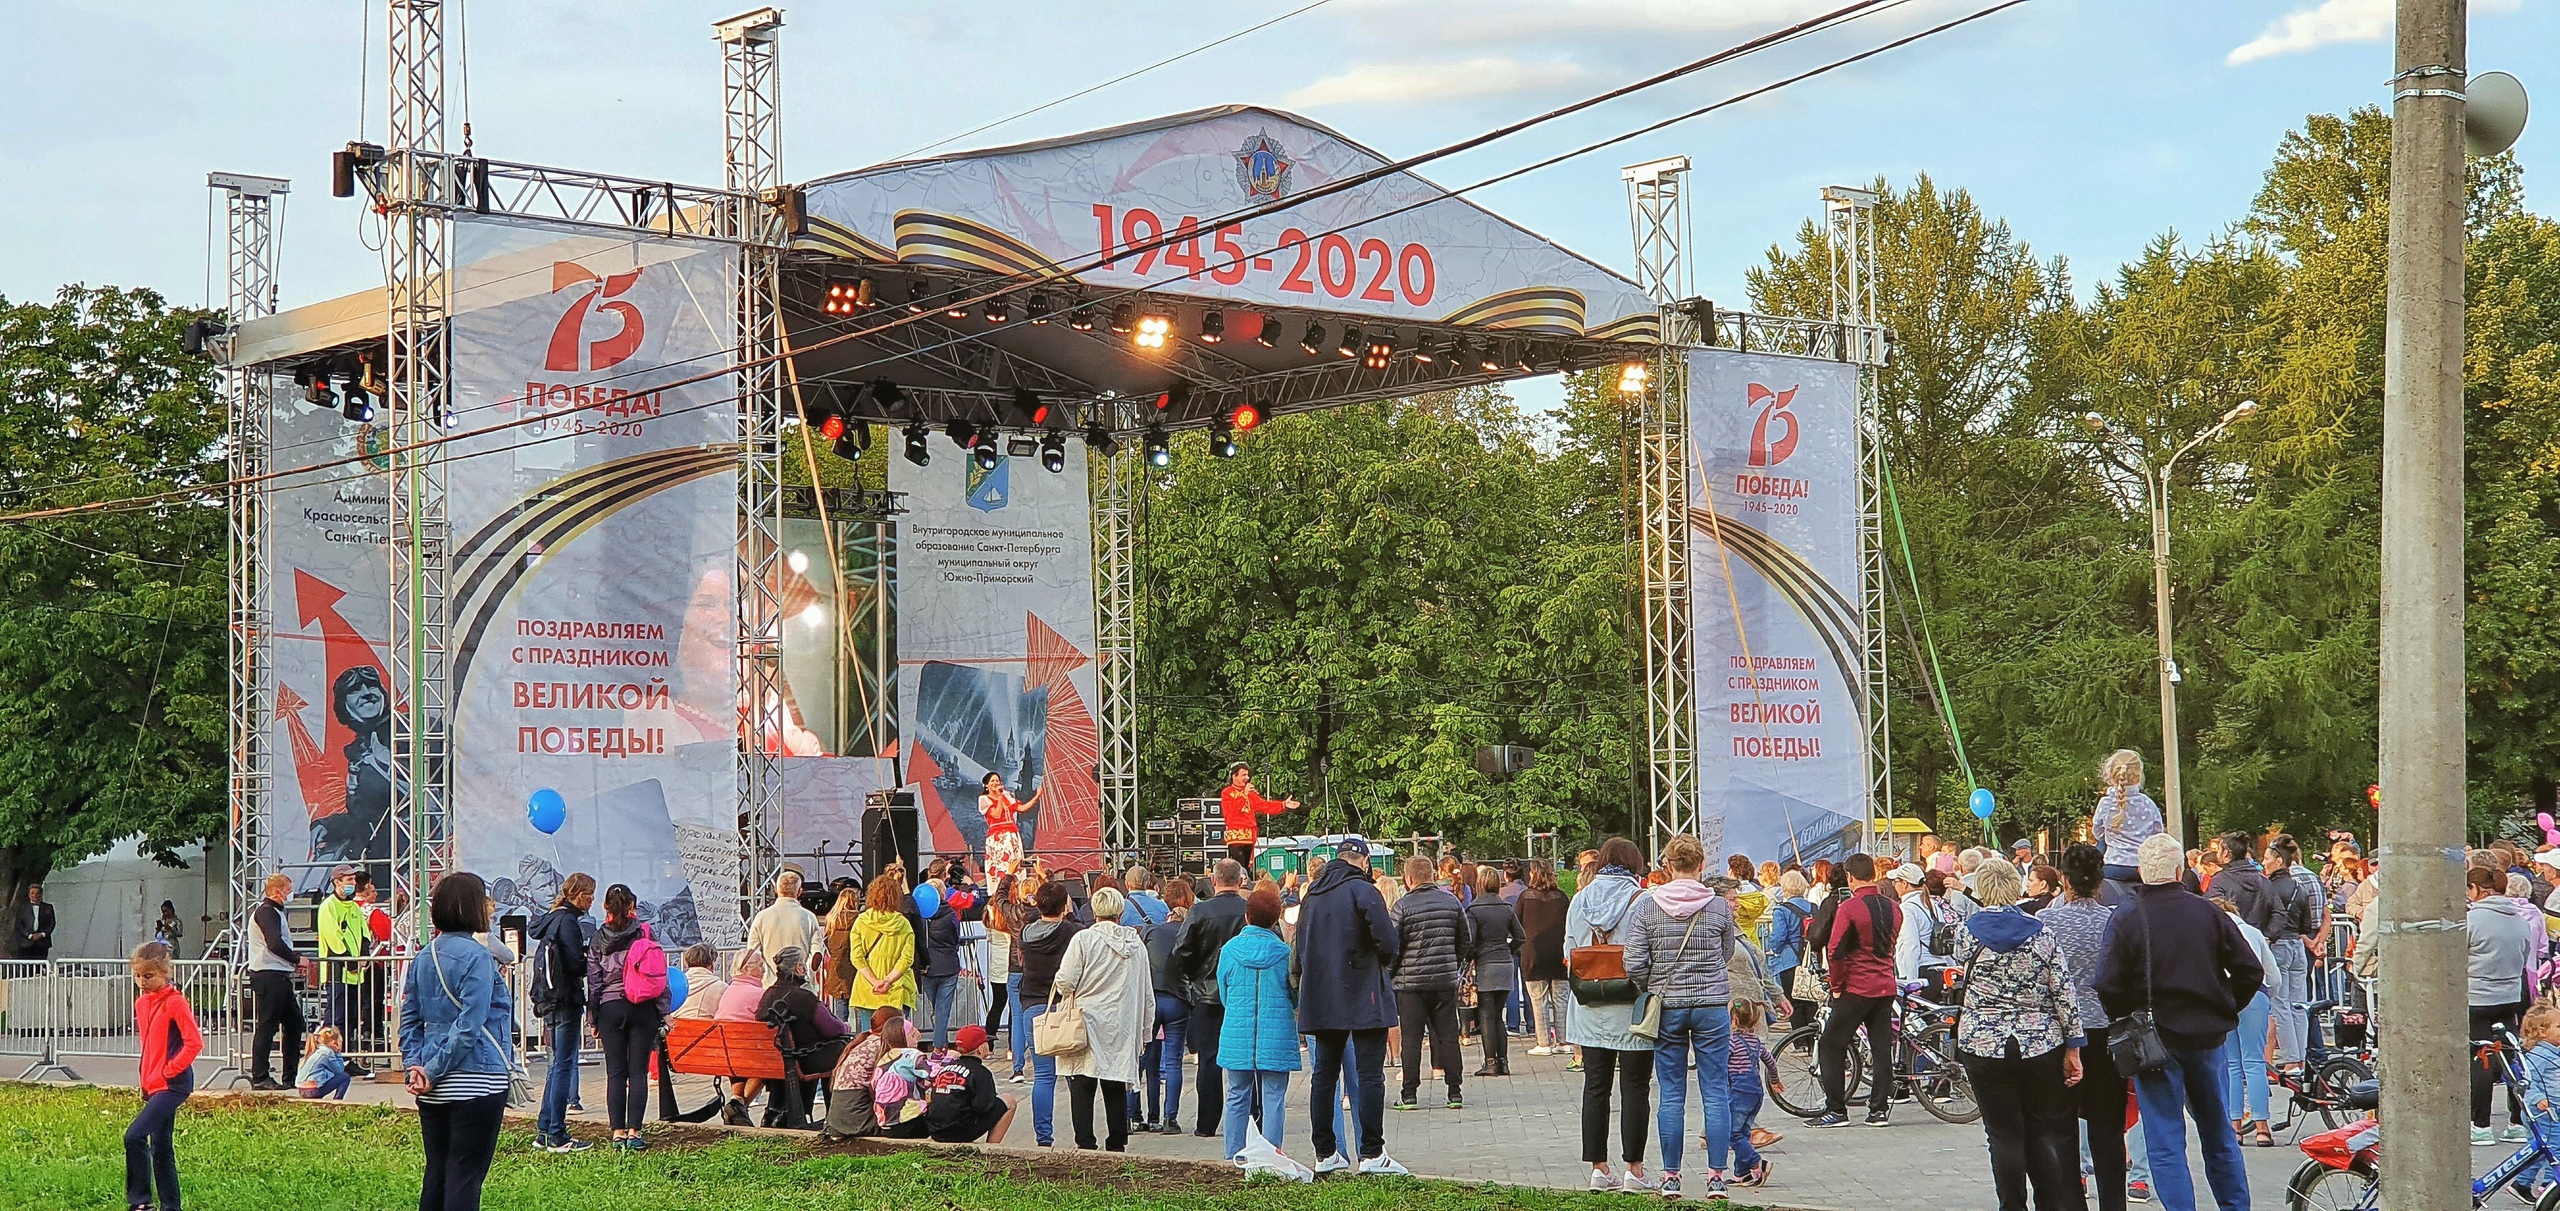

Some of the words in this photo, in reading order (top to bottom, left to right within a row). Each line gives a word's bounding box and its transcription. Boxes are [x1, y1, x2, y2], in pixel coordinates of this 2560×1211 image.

[1092, 203, 1436, 307] 1945-2020
[526, 381, 662, 418] ПОБЕДА!
[1736, 474, 1809, 501] ПОБЕДА!
[912, 523, 990, 538] Внутригородское
[991, 528, 1064, 539] муниципальное
[915, 539, 975, 552] образование
[976, 541, 1061, 555] Санкт-Петербурга
[937, 557, 1011, 569] муниципальный
[1012, 560, 1039, 570] округ
[944, 571, 1034, 585] Южно-Приморский
[517, 619, 664, 641] ПОЗДРАВЛЯЕМ
[511, 647, 524, 664] С
[529, 647, 669, 668] ПРАЗДНИКОМ
[1730, 655, 1815, 671] ПОДРАВЛЯЕМ
[513, 677, 669, 710] ВЕЛИКОЙ
[1728, 676, 1735, 689] С
[1730, 699, 1821, 724] ВЕЛИКОЙ
[518, 726, 664, 759] ПОБЕДЫ!
[1733, 736, 1821, 761] ПОБЕДЫ!
[2482, 1143, 2533, 1188] STELS
